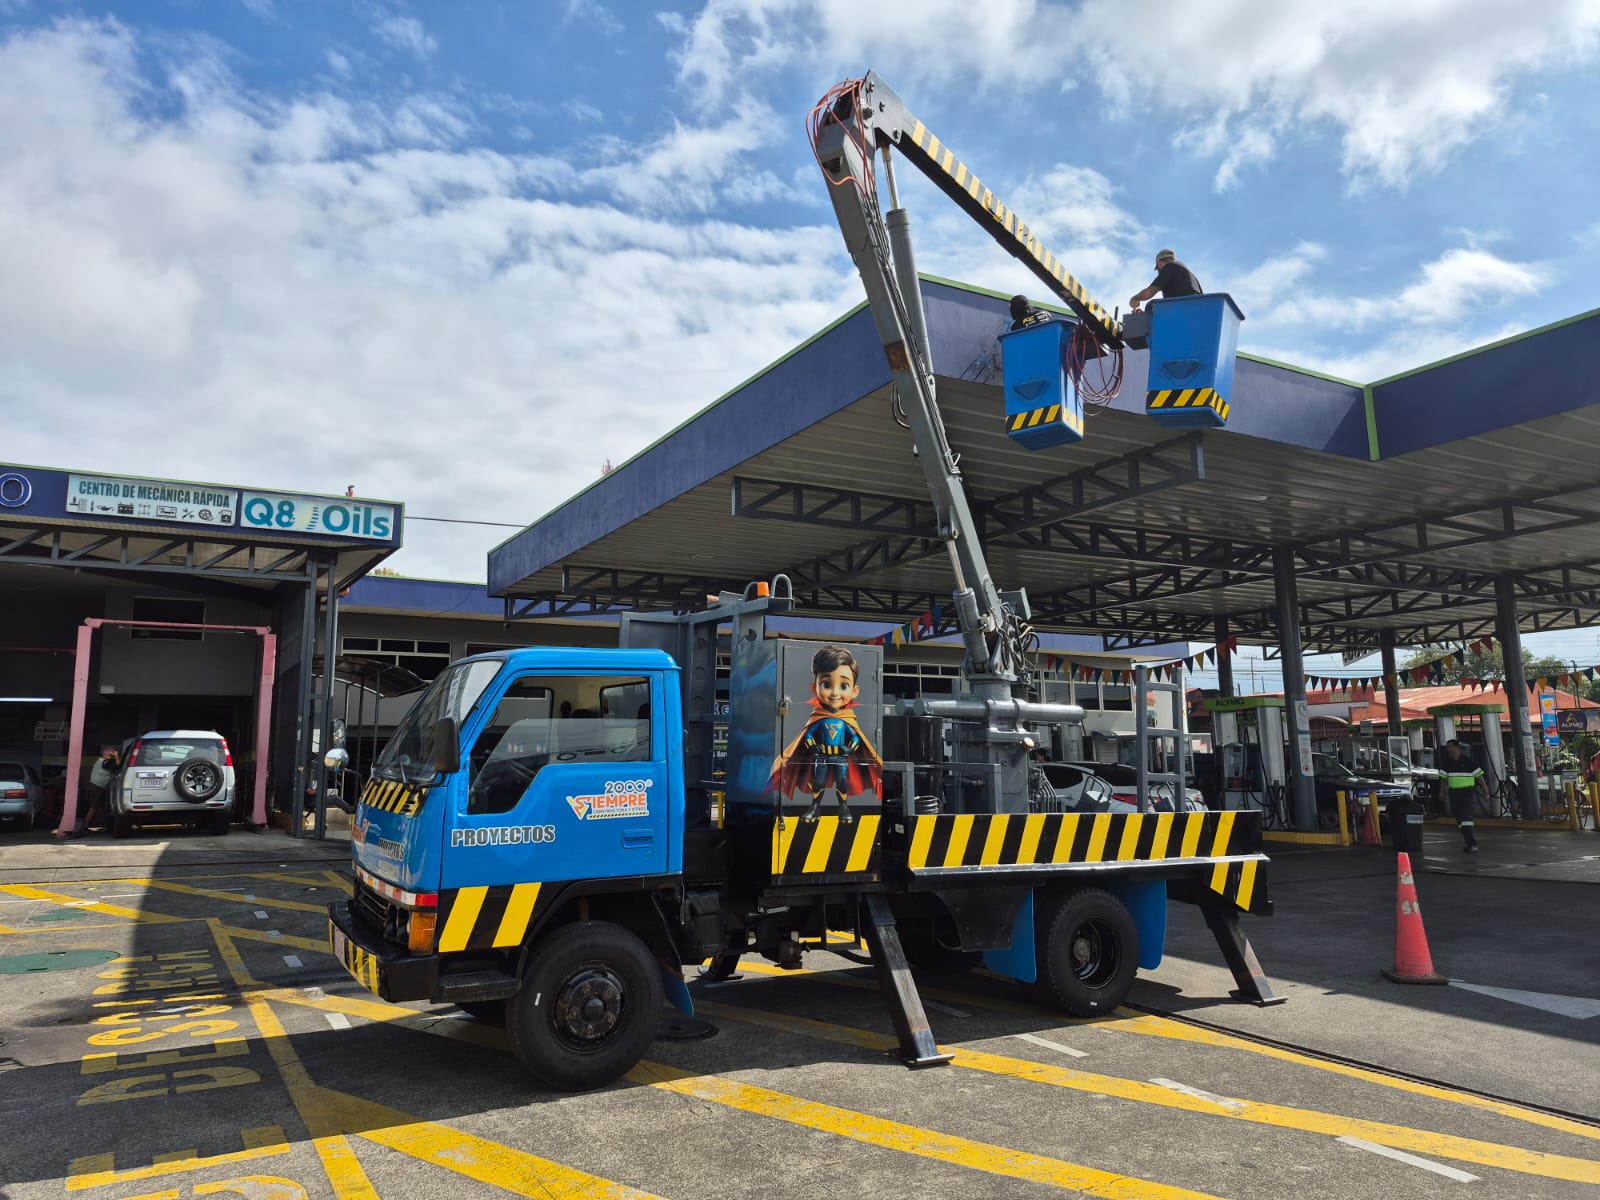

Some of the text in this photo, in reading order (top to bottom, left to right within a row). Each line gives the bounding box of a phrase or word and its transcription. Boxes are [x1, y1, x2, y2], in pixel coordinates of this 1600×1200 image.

[79, 480, 230, 508] CENTRO DE MECÁNICA RÁPIDA
[244, 497, 390, 538] Q8 Oils
[1215, 697, 1245, 706] ALYMO
[1562, 721, 1584, 729] ALYMO
[574, 793, 647, 818] SIEMPRE
[451, 825, 556, 847] PROYECTOS
